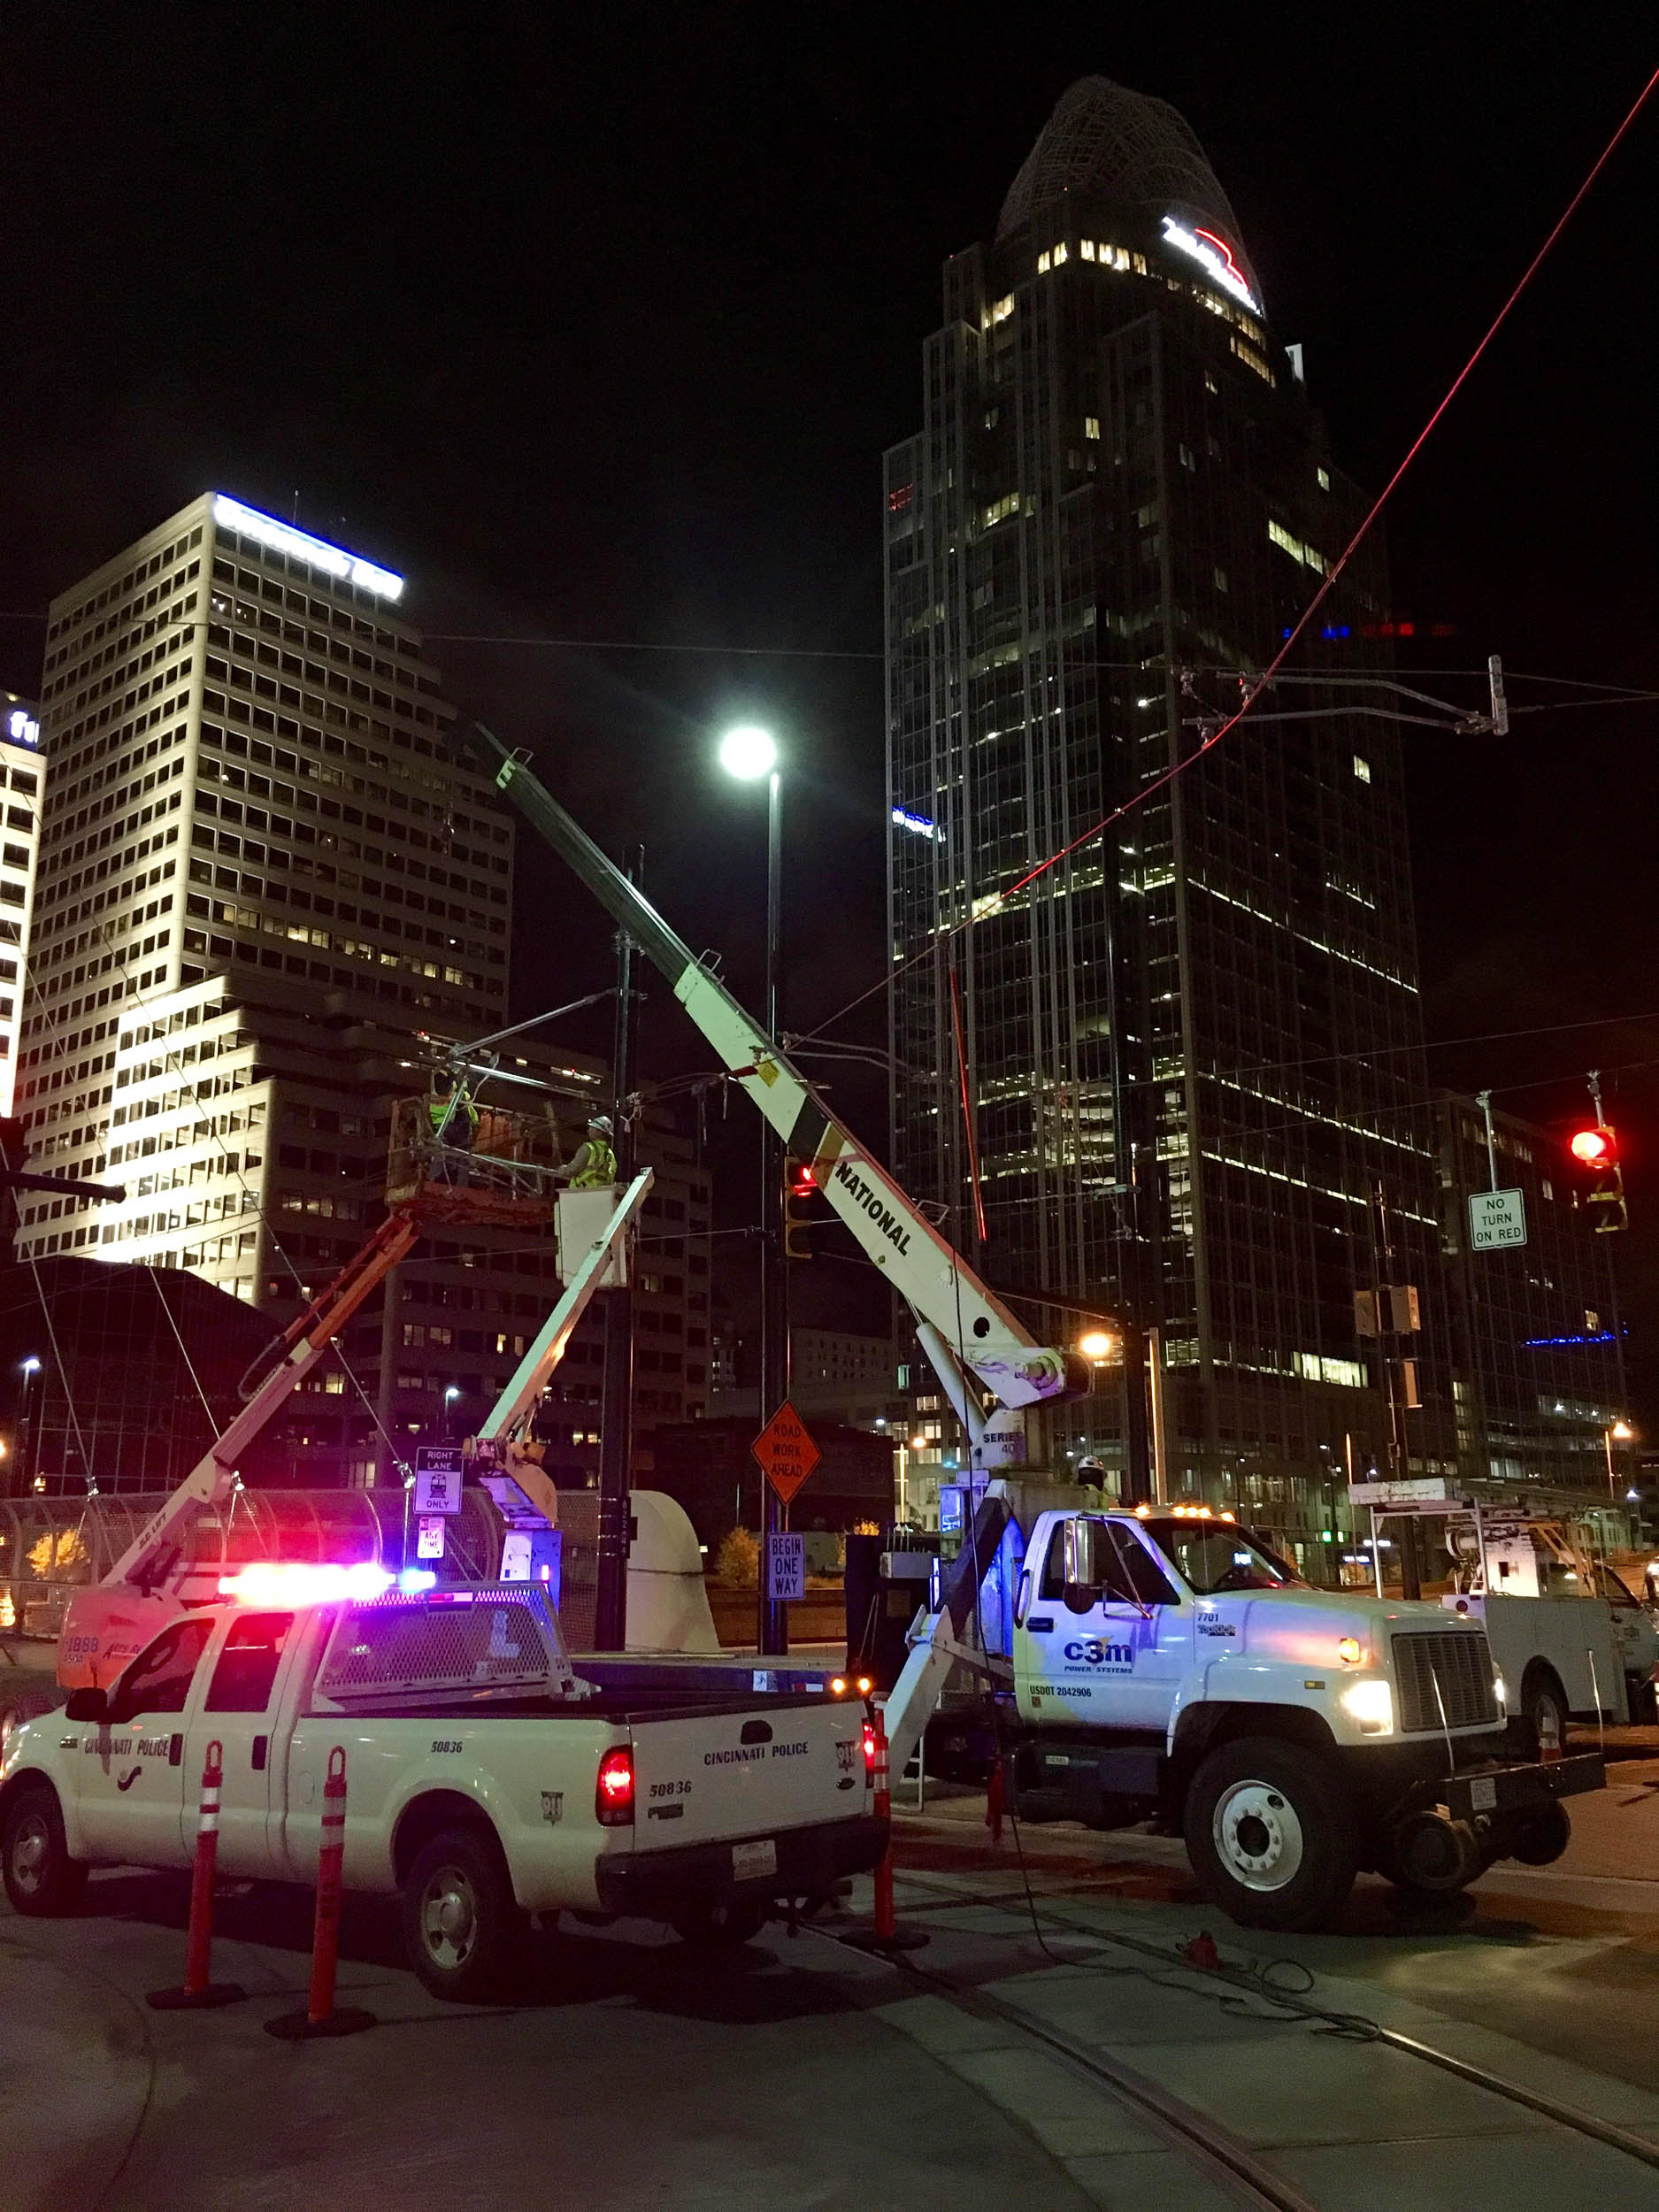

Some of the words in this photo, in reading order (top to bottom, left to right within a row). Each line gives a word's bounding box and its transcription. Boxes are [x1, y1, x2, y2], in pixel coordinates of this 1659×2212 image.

[835, 1161, 910, 1256] NATIONAL
[1486, 1198, 1505, 1210] NO
[1481, 1213, 1512, 1225] TURN
[1476, 1231, 1492, 1242] ON
[1499, 1227, 1521, 1240] RED
[773, 1423, 802, 1438] ROAD
[772, 1443, 801, 1458] WORK
[771, 1463, 803, 1478] AHEAD
[772, 1538, 801, 1555] BEGIN
[775, 1558, 798, 1574] ONE
[775, 1578, 798, 1594] WAY
[1197, 1613, 1218, 1622] 7701
[1064, 1640, 1133, 1663] c3m
[1029, 1686, 1055, 1695] USDOT
[1056, 1686, 1092, 1697] 2042906
[137, 1740, 169, 1756] POLICE
[431, 1740, 464, 1754] 50836
[704, 1748, 765, 1766] CINCINNATI
[772, 1741, 810, 1758] POLICE
[649, 1780, 692, 1798] 50836
